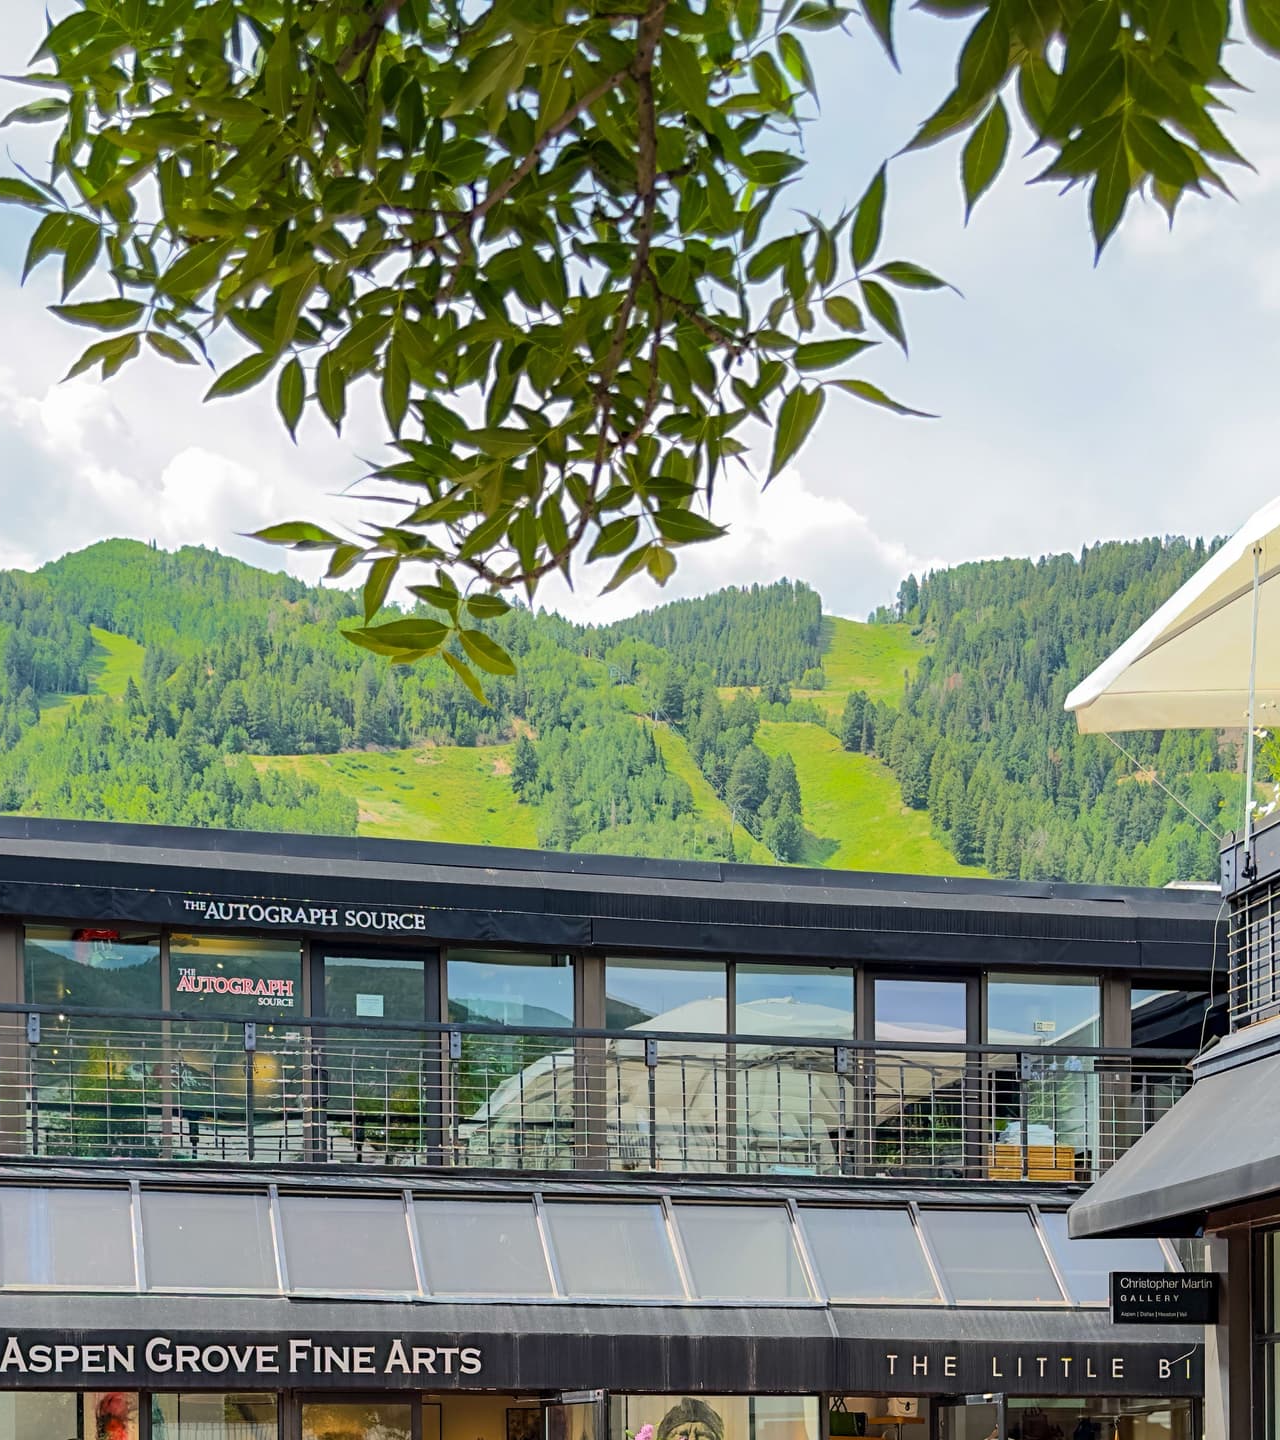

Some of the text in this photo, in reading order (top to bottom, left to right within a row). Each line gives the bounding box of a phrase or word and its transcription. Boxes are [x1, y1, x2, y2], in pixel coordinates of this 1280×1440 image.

[184, 900, 426, 930] THE AUTOGRAPH SOURCE
[178, 968, 196, 977] THE
[177, 975, 294, 998] AUTOGRAPH
[258, 997, 294, 1007] SOURCE
[1120, 1277, 1213, 1291] Christopher Martin
[1120, 1294, 1180, 1302] GALLERY
[145, 1337, 280, 1374] GROVE
[288, 1339, 376, 1374] FINE
[384, 1339, 483, 1375] ARTS
[886, 1355, 957, 1377] THE
[992, 1357, 1124, 1378] LITTLE
